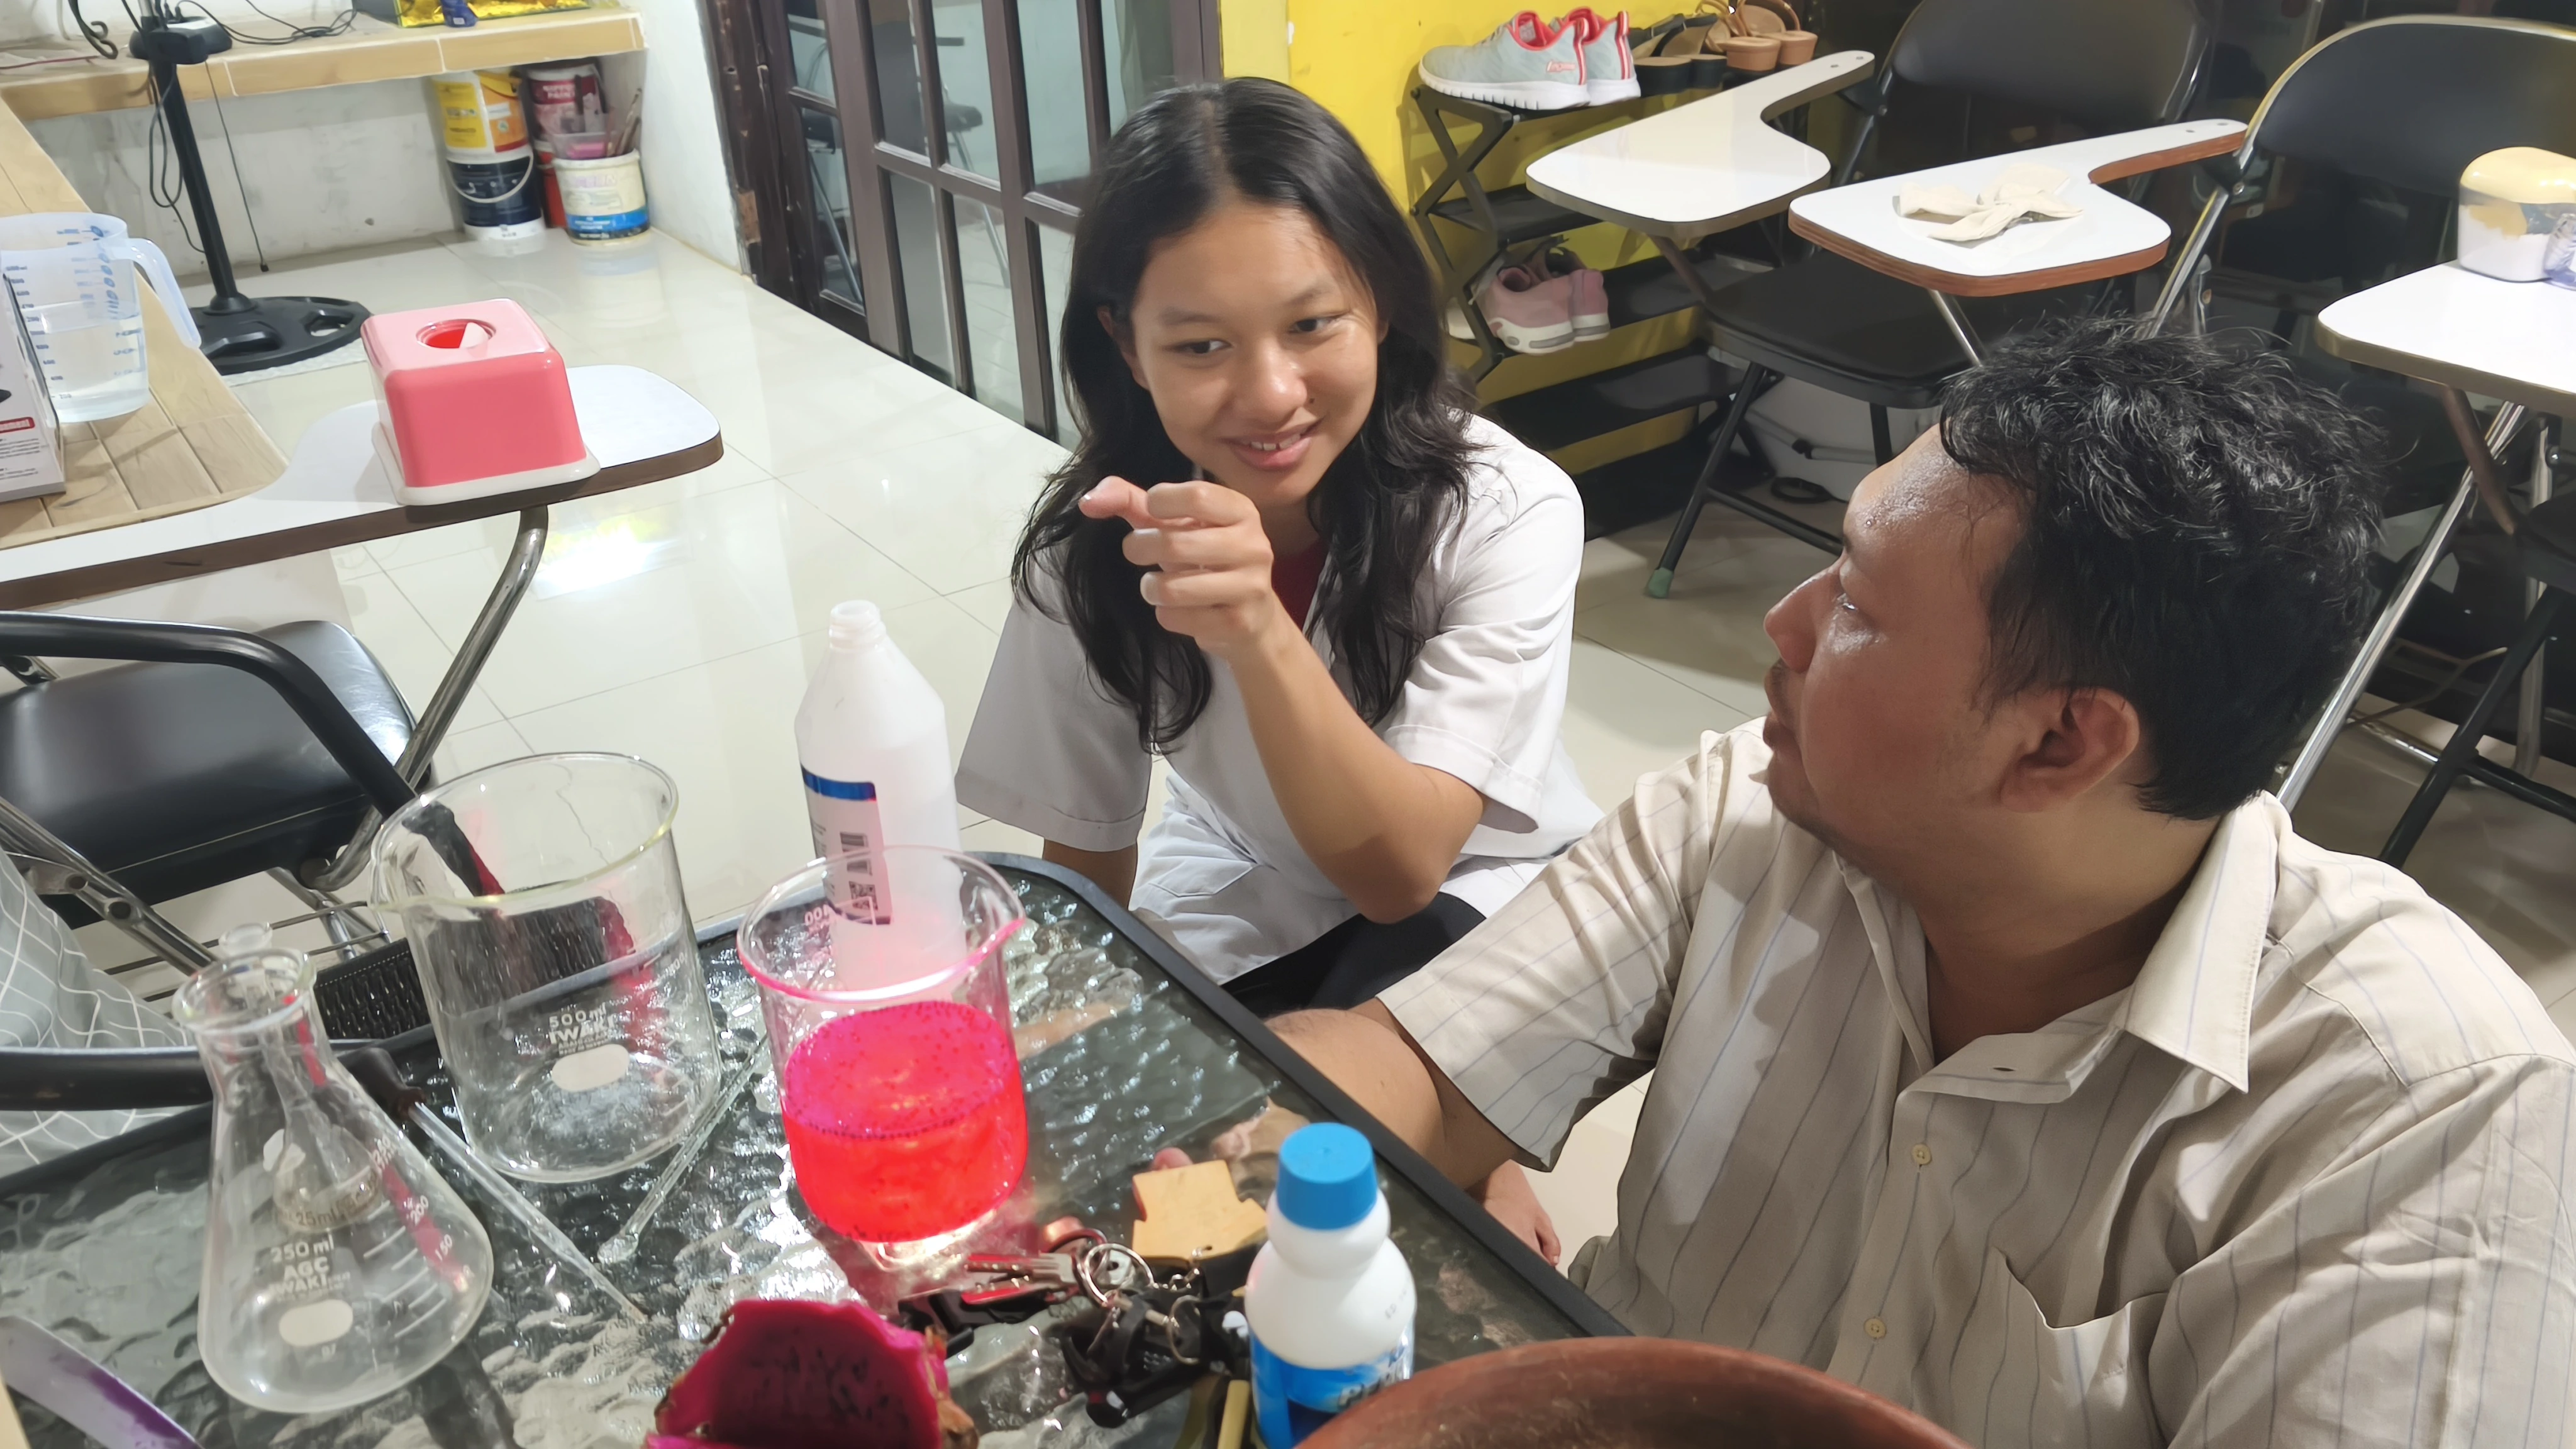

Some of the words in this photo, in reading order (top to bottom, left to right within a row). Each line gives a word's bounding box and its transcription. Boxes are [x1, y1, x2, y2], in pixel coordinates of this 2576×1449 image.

[411, 1195, 429, 1225] 200
[270, 1241, 310, 1263] 250
[435, 1234, 453, 1261] 150
[283, 1256, 330, 1281] AGC
